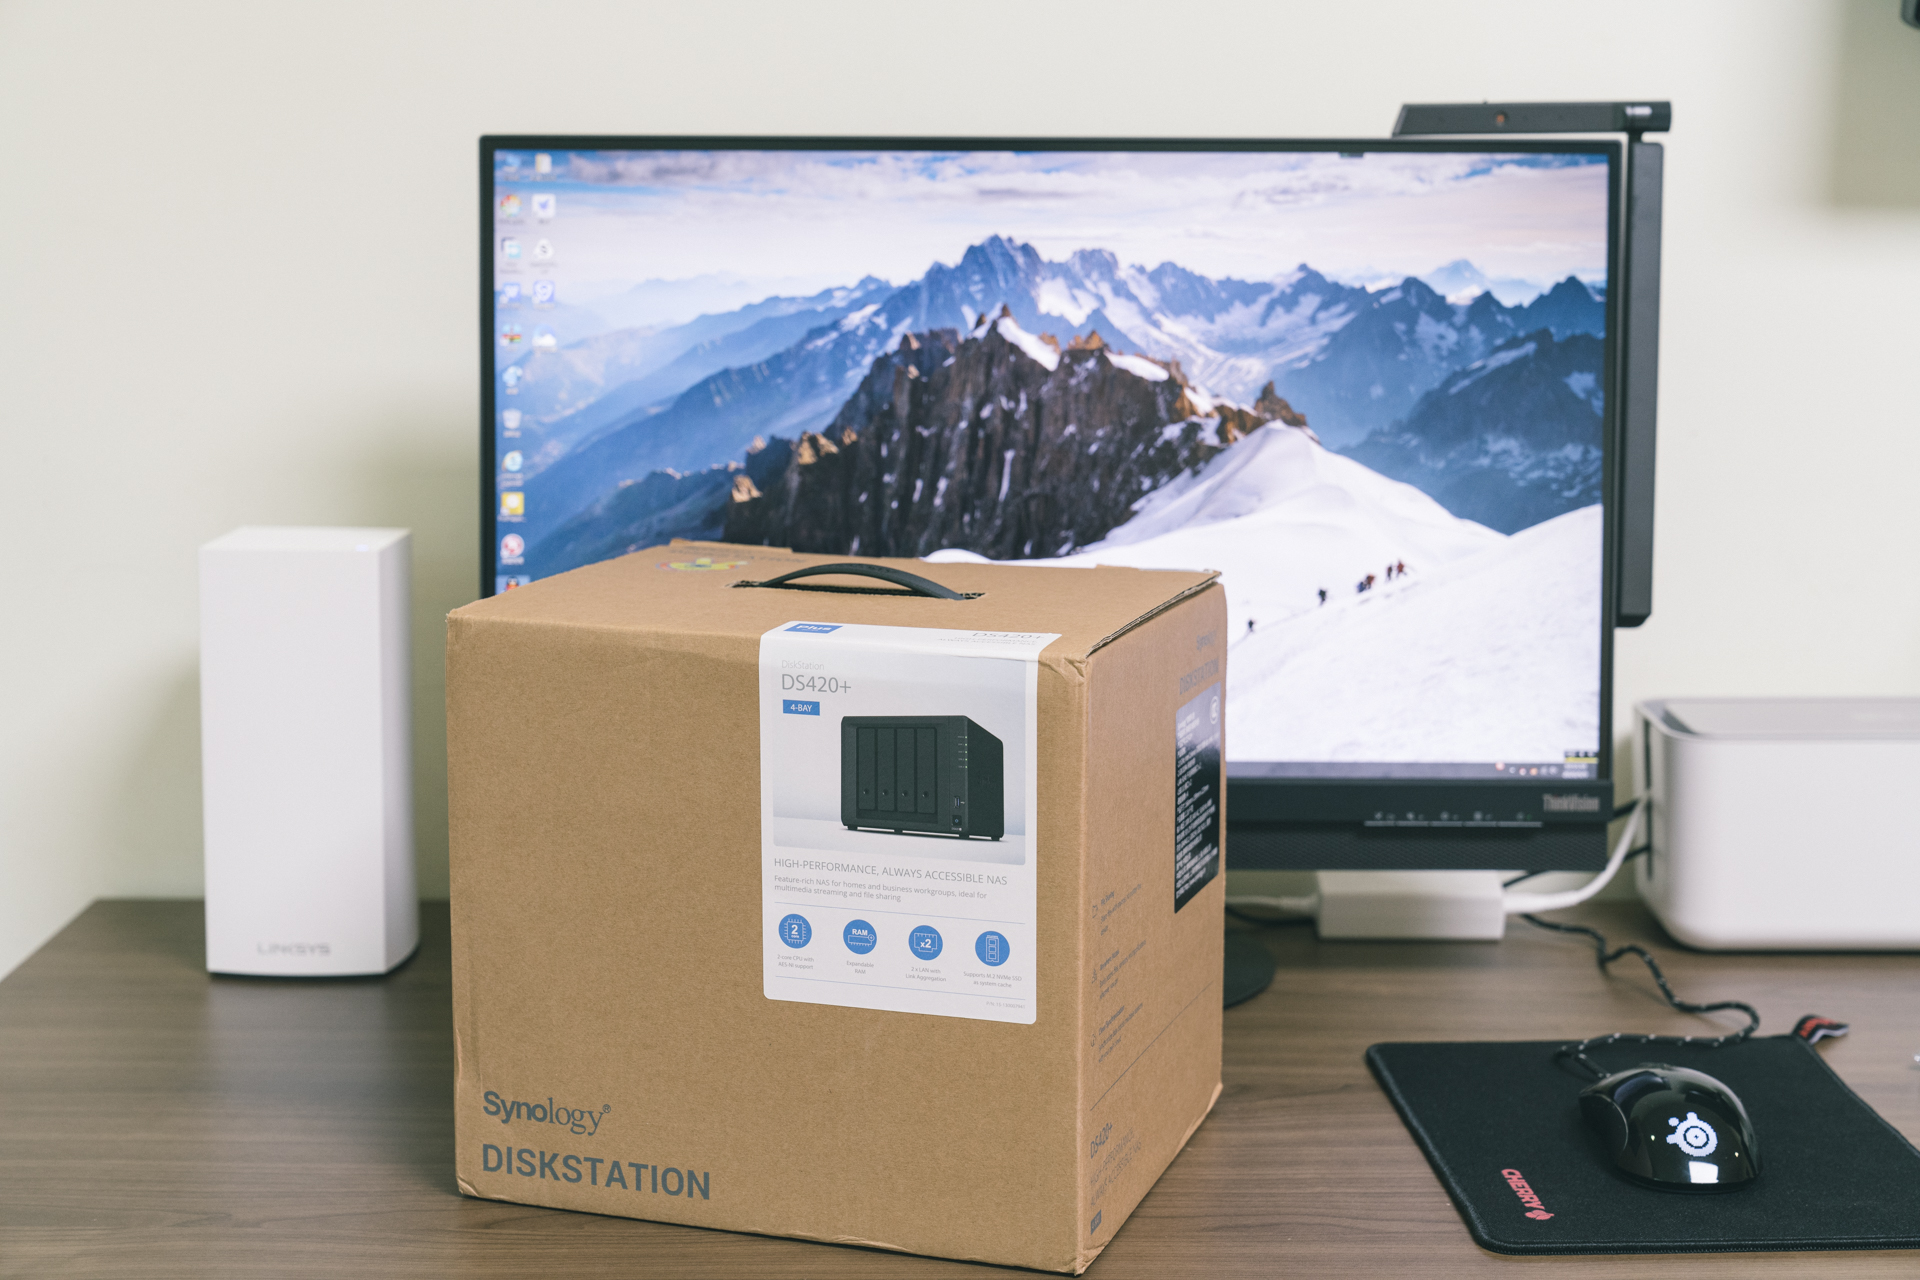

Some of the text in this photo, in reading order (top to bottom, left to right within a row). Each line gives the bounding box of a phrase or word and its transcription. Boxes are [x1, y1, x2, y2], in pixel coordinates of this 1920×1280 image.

[782, 659, 824, 670] DiskStation
[782, 674, 852, 694] DS420+
[790, 704, 812, 712] 4-BAY
[1542, 793, 1600, 812] ThinkVision
[774, 858, 1008, 886] HIGH-PERFORMANCE, ALWAYS ACCESSIBLE NAS
[774, 875, 814, 885] Feature-rich
[843, 881, 866, 890] homes
[882, 884, 912, 893] business
[914, 888, 957, 898] workgroups,
[958, 890, 976, 898] ideal
[774, 884, 812, 894] multimedia
[814, 888, 848, 898] streaming
[864, 891, 874, 899] file
[876, 894, 902, 902] sharing
[791, 924, 798, 935] 2
[852, 928, 868, 936] RAM
[257, 942, 332, 956] LINKSYS
[920, 938, 932, 948] x2
[846, 960, 874, 968] Expandable
[963, 971, 986, 979] Supports
[1090, 1122, 1112, 1160] DS420+
[482, 1143, 710, 1200] DISKSTATION
[1501, 1168, 1546, 1210] CHERRY
